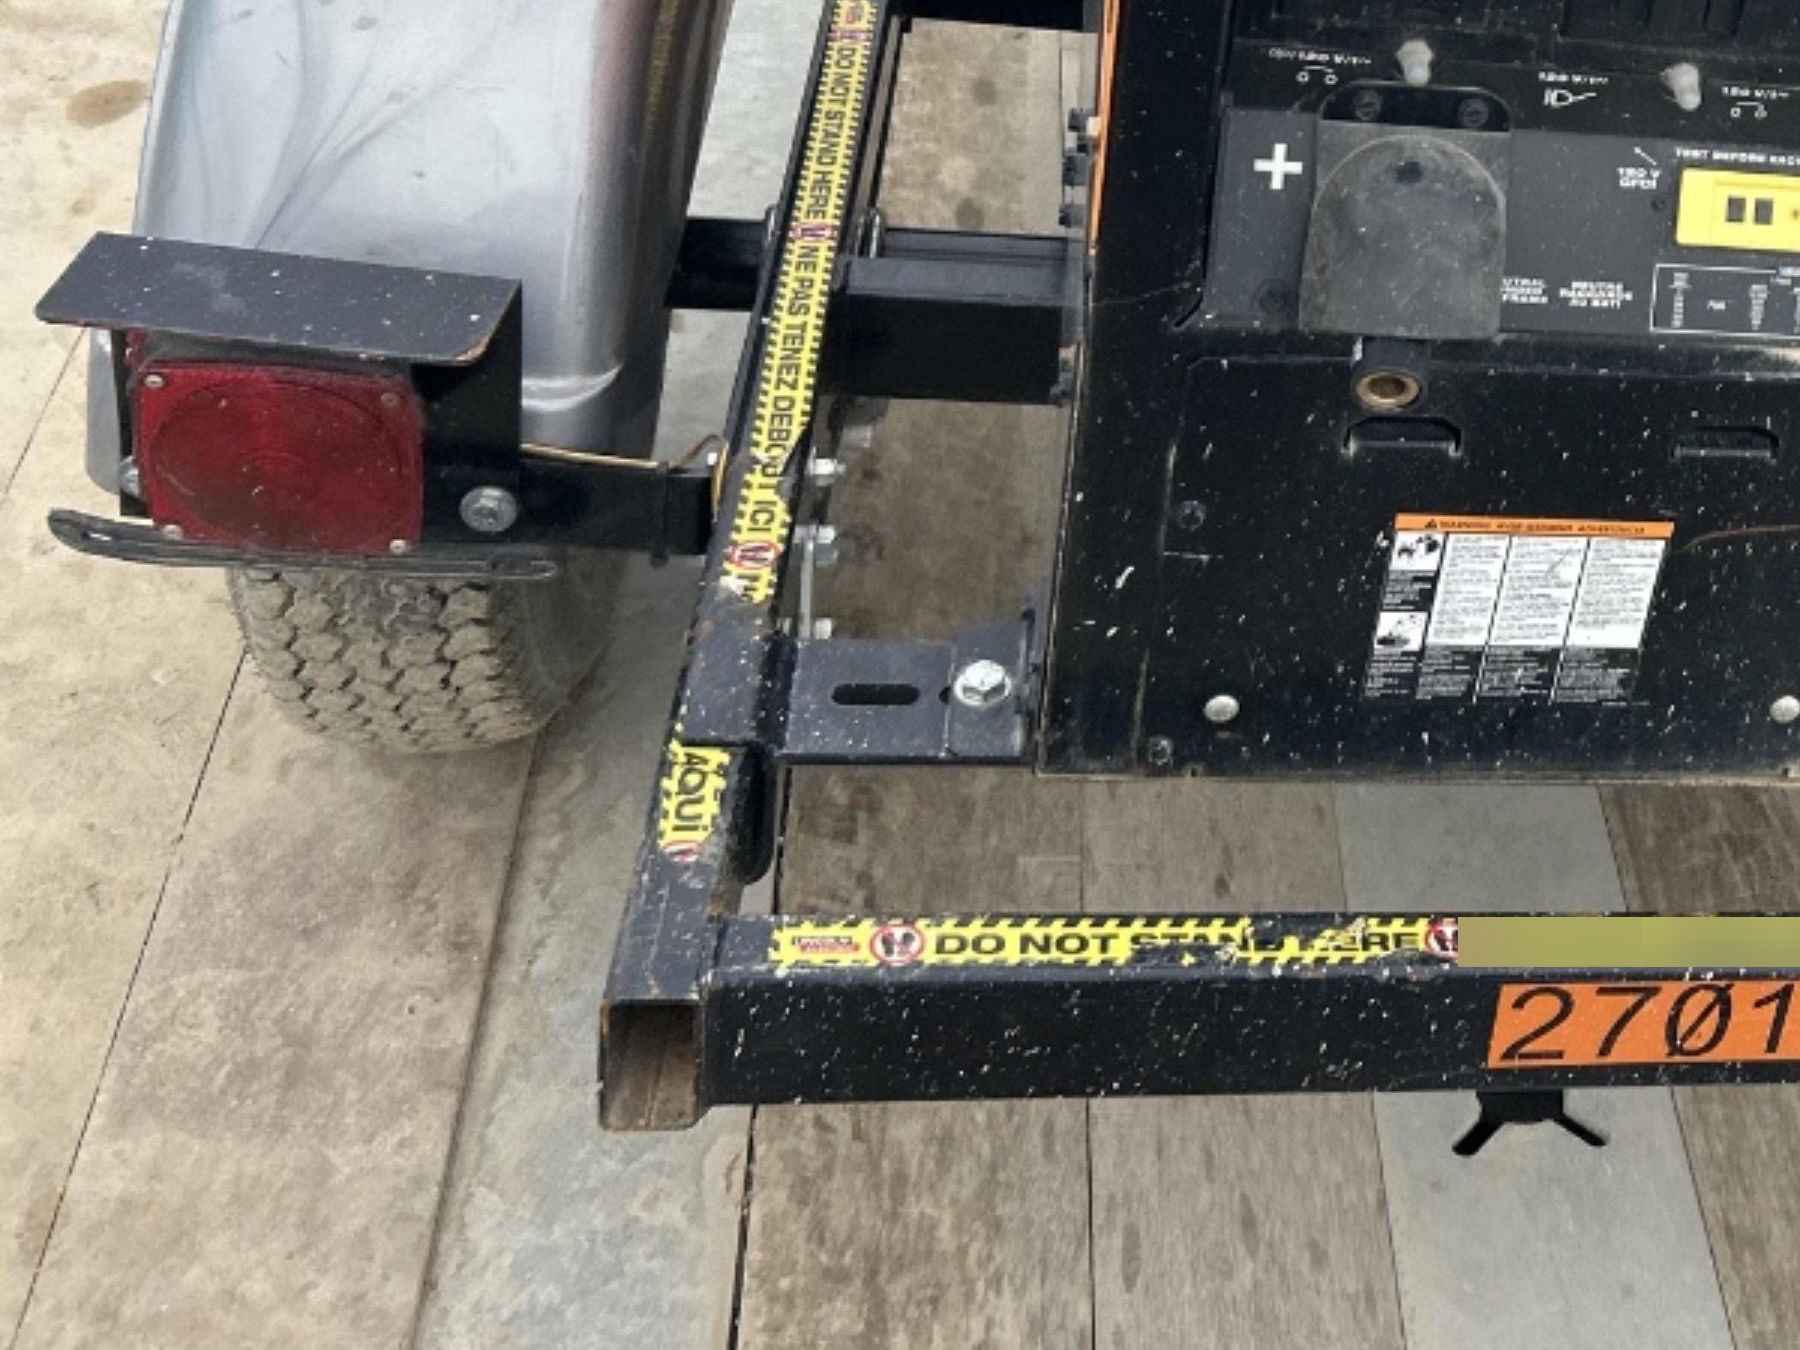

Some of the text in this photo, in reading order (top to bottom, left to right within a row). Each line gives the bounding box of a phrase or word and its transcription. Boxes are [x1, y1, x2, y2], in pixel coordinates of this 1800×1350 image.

[835, 45, 856, 76] DO
[830, 73, 854, 105] NOT
[816, 109, 847, 167] STAND
[1675, 147, 1709, 160] TEST
[1712, 151, 1767, 164] BEFORE
[806, 168, 835, 221] HERE
[795, 244, 821, 276] NE
[787, 276, 814, 317] PAS
[772, 320, 808, 392] TENEZ
[747, 499, 778, 532] ICI
[935, 932, 1006, 955] DO
[1019, 932, 1119, 955] NOT
